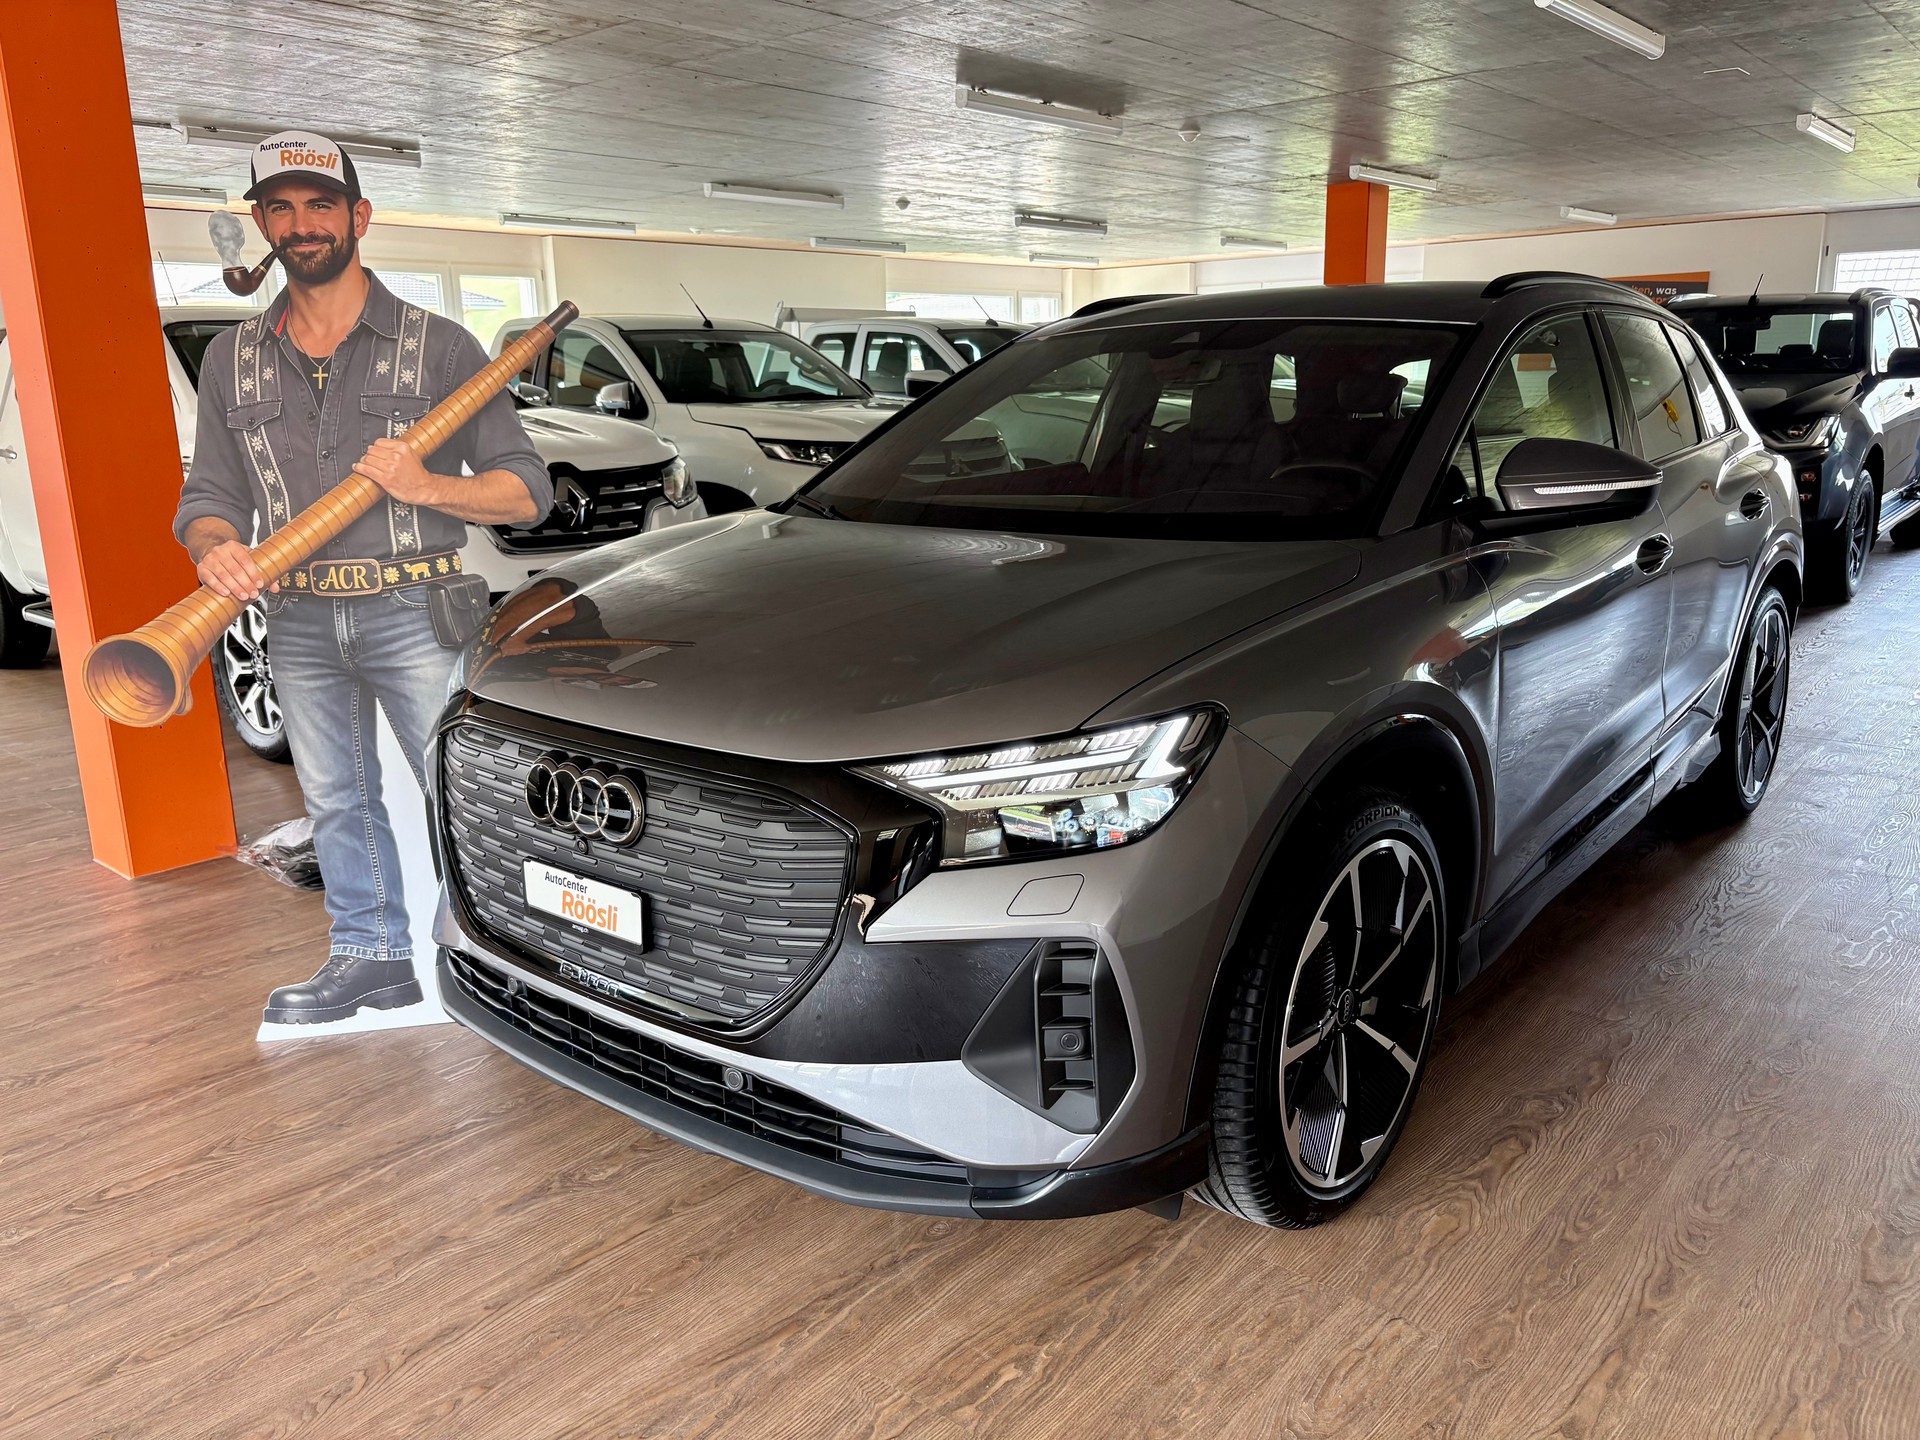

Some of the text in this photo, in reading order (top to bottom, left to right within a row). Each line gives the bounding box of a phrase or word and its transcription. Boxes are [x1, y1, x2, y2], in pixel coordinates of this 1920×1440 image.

[259, 140, 308, 152] AutoCenter
[280, 149, 339, 170] Röösli
[1656, 286, 1677, 295] was
[319, 565, 371, 590] ACR
[544, 871, 588, 894] AutoCenter
[561, 890, 618, 932] Röösli
